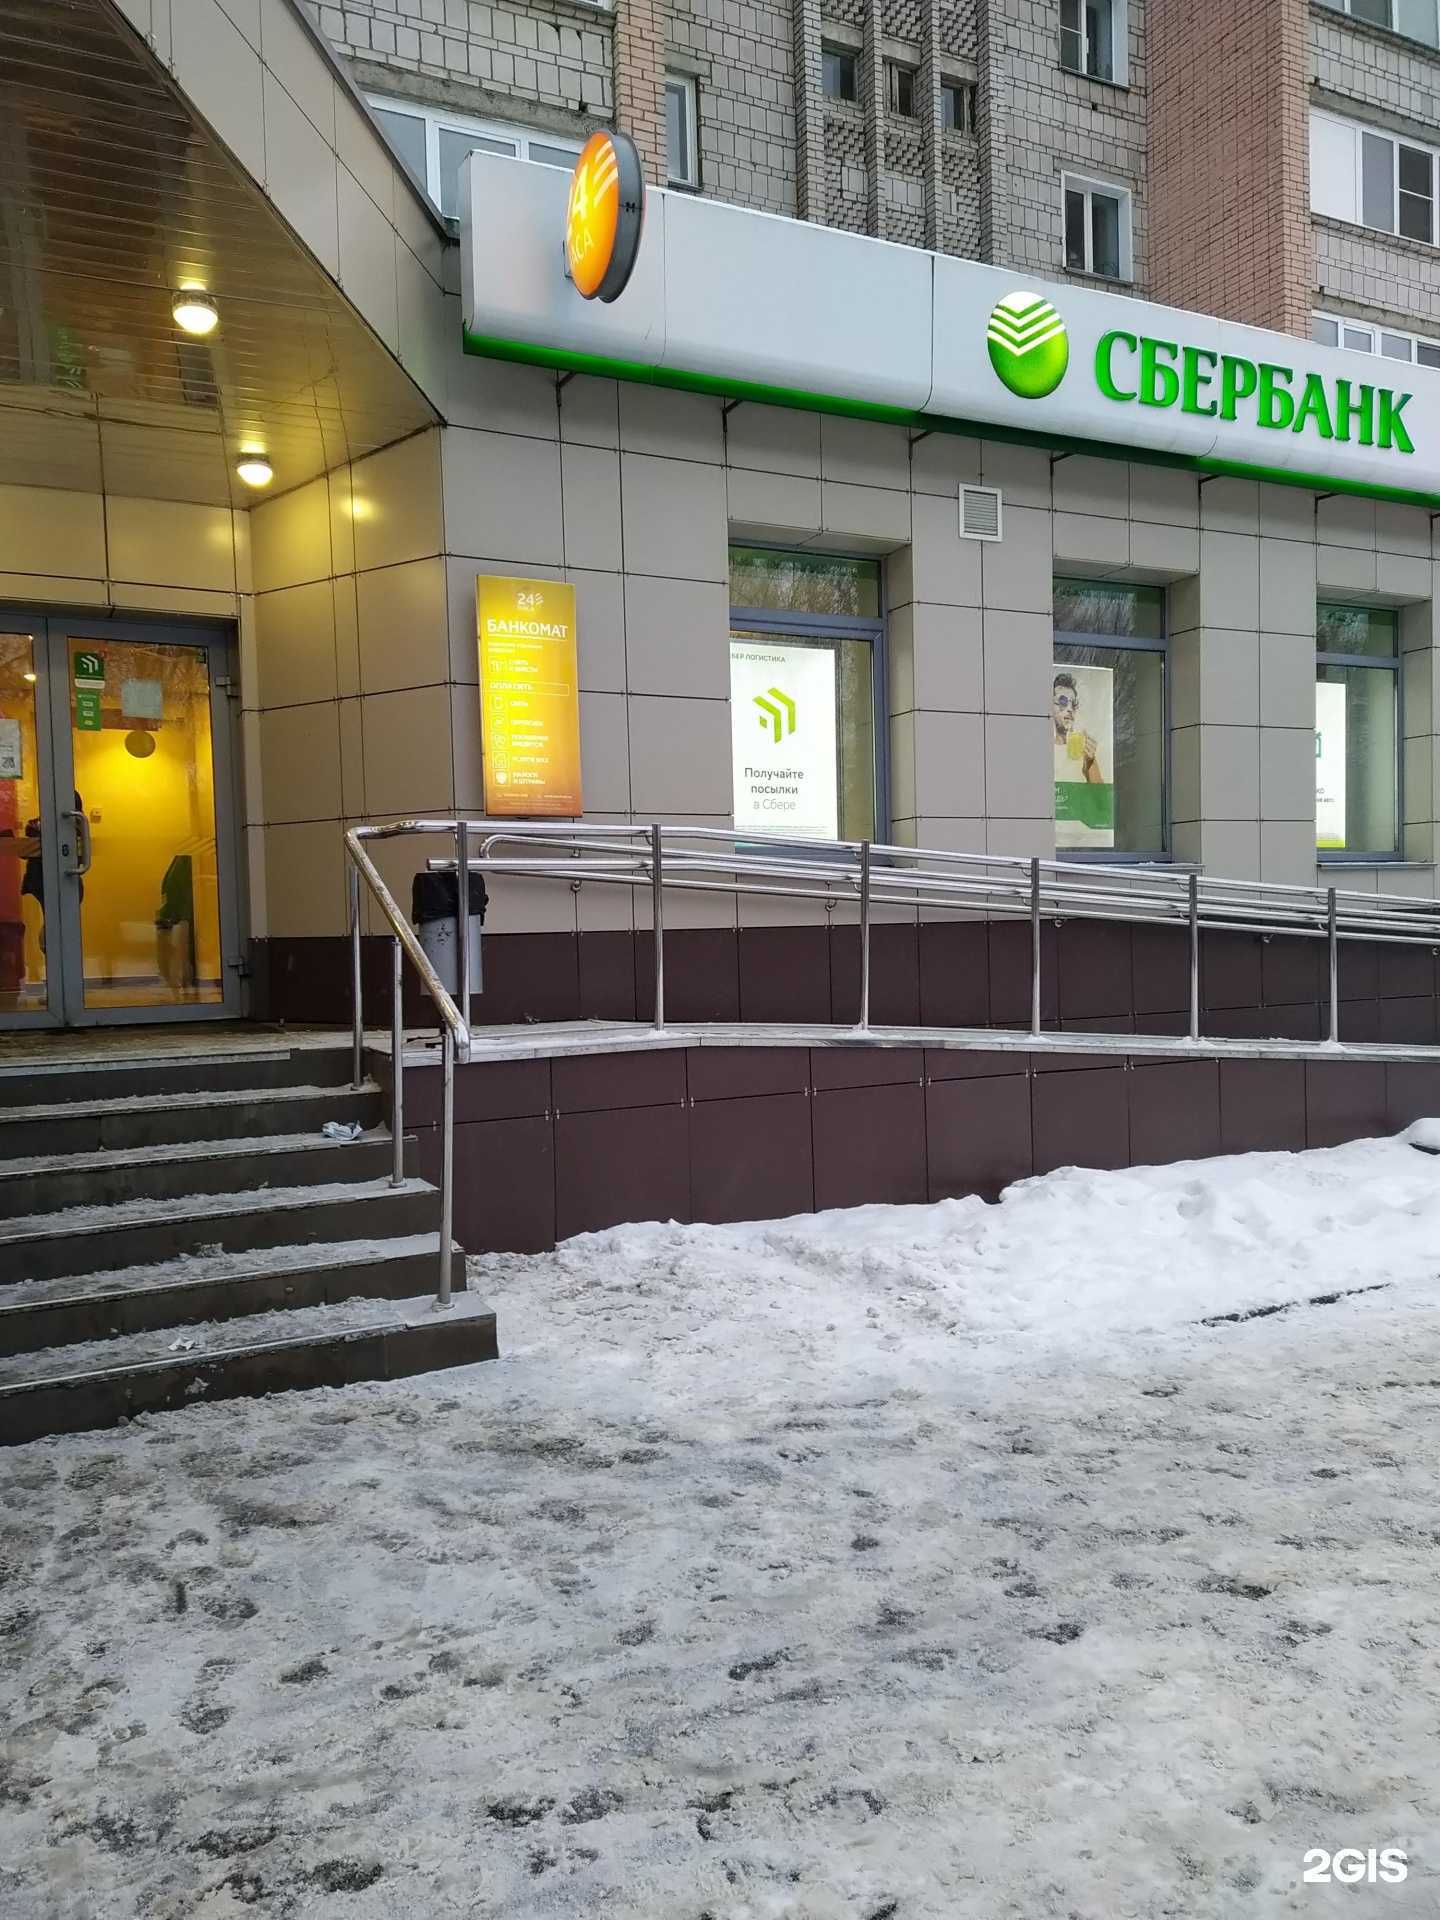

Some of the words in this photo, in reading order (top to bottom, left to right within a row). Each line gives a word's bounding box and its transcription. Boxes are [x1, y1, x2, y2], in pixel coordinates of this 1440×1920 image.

[1095, 328, 1416, 454] СБЕРБАНК
[517, 592, 535, 606] 24
[487, 618, 569, 638] БАНКОМАТ
[746, 654, 786, 662] ЛОГИСТИКА
[744, 767, 805, 780] Получайте
[751, 785, 799, 795] посылки
[753, 801, 760, 810] в
[762, 799, 796, 812] Сбере
